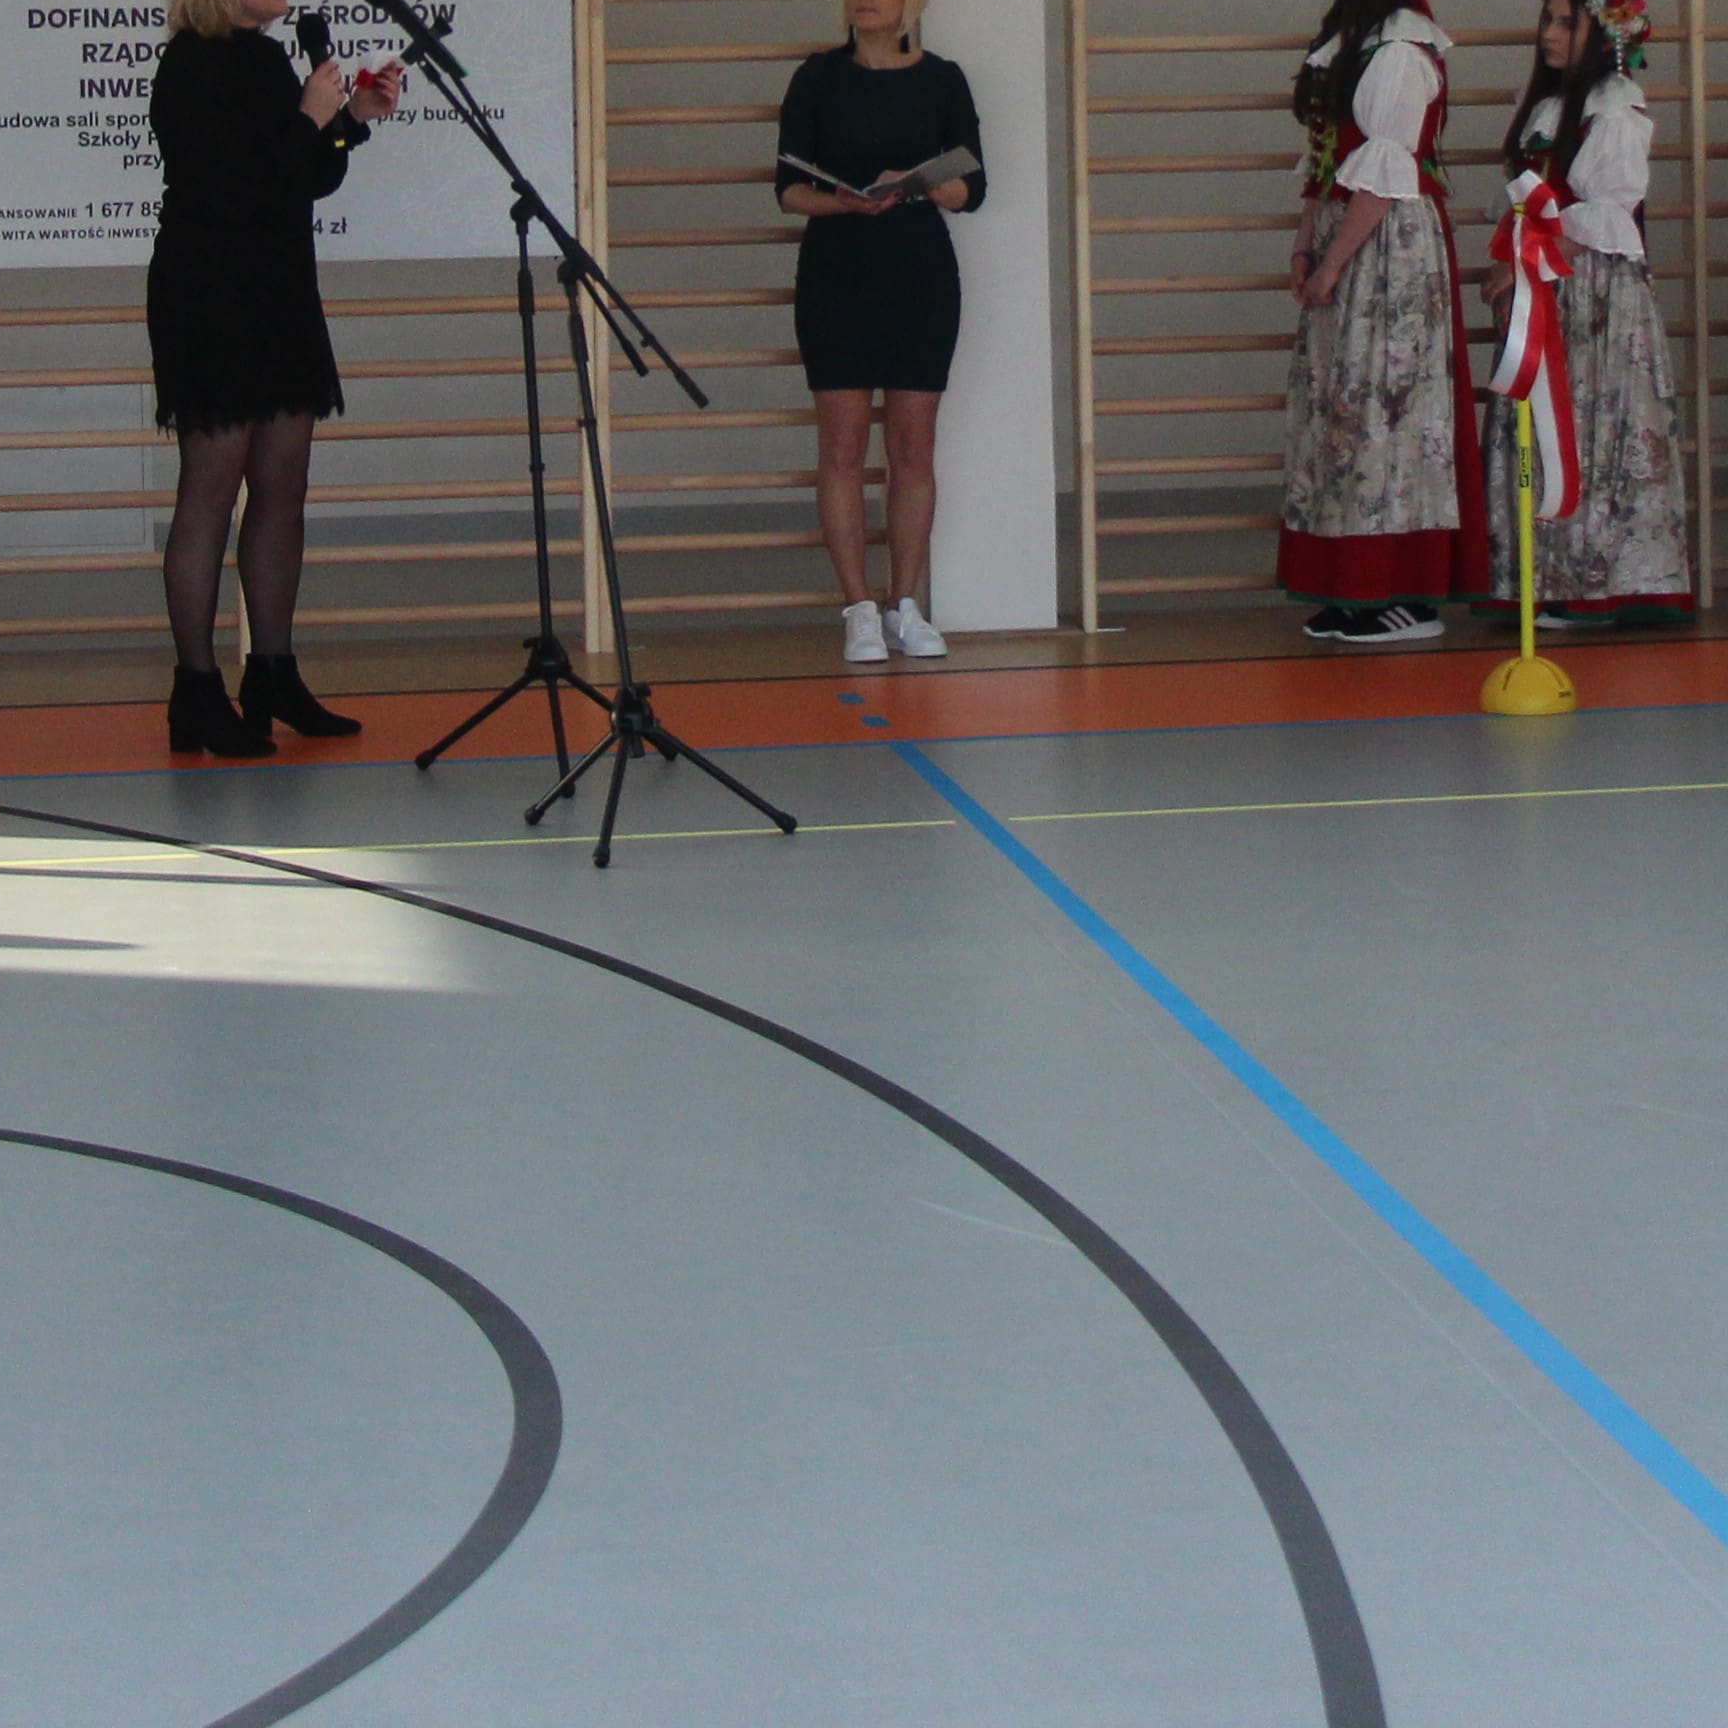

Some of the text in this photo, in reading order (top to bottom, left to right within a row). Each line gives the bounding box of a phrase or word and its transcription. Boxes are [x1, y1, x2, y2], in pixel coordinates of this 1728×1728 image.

[27, 7, 167, 30] DOFINANS
[79, 77, 154, 99] INWE
[66, 111, 99, 128] sali
[105, 113, 150, 130] spor
[77, 129, 142, 150] Szkoły
[122, 153, 163, 170] przy
[84, 202, 94, 218] 1
[101, 201, 134, 218] 677
[140, 201, 163, 218] 85
[39, 226, 104, 241] WARTOŚĆ
[108, 227, 158, 239] INWEST
[329, 216, 348, 235] zł
